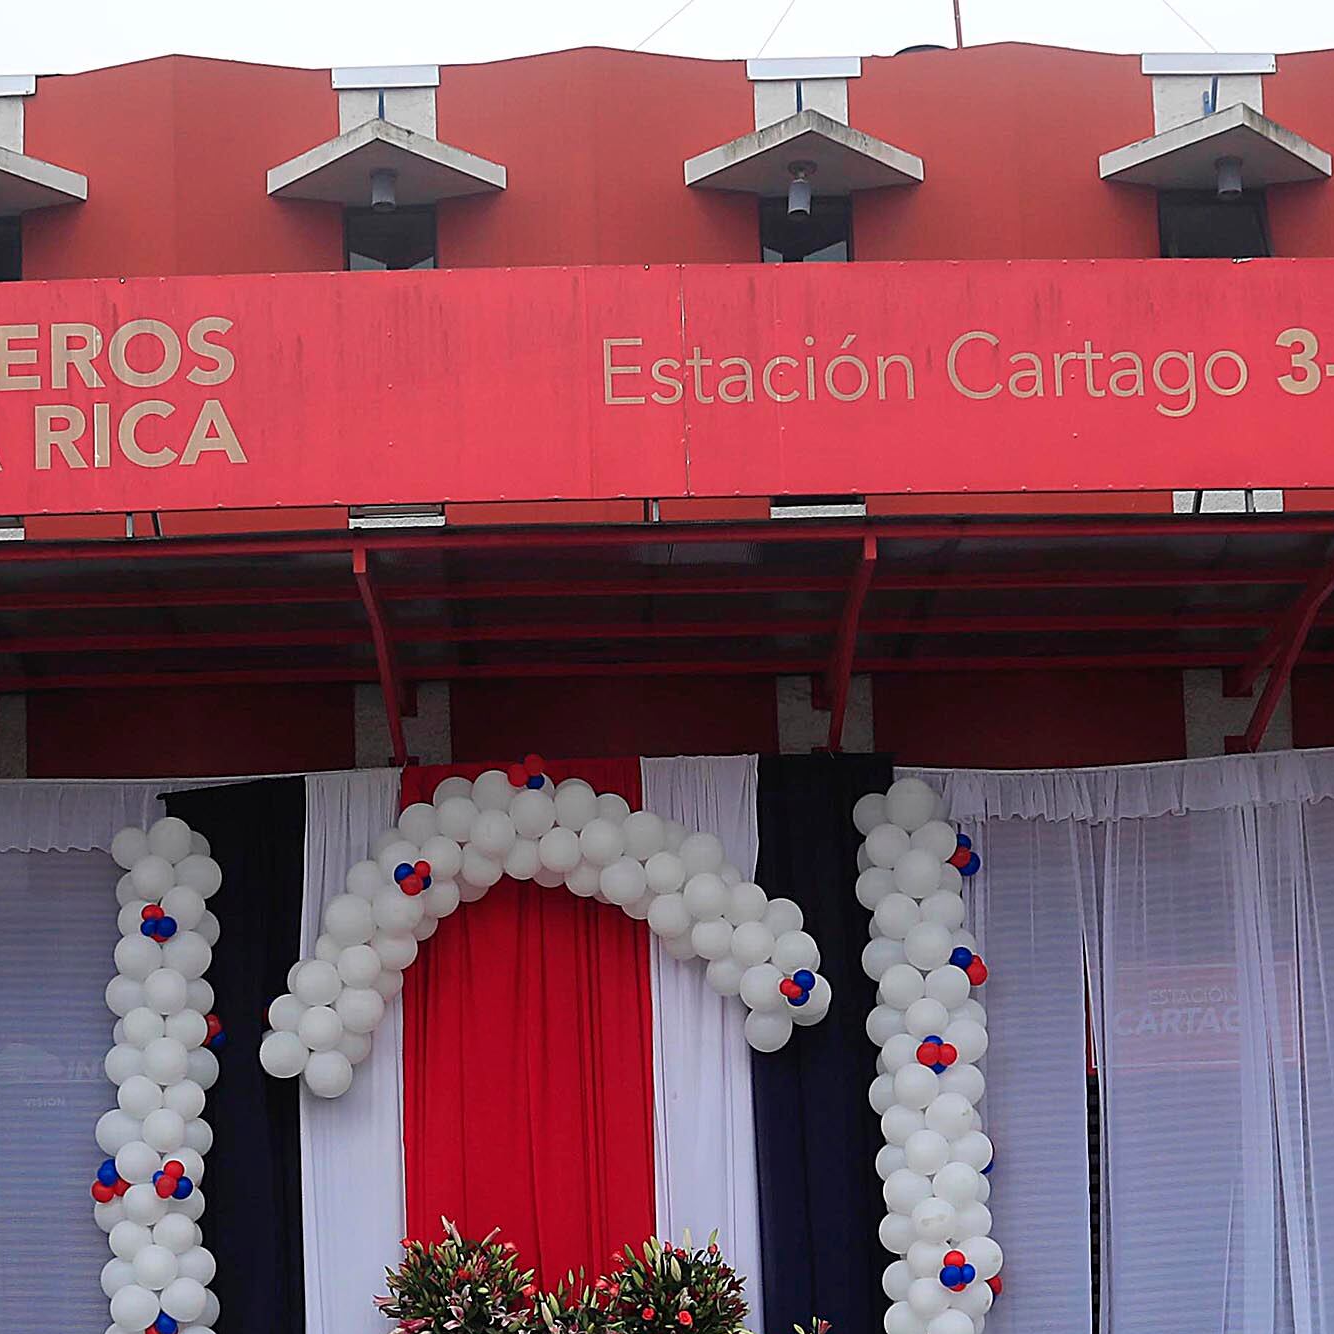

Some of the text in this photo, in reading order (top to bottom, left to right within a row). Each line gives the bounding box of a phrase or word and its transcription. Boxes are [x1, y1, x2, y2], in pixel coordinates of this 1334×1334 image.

[604, 331, 916, 406] Estación
[946, 329, 1250, 418] Cartago
[34, 398, 249, 471] RICA
